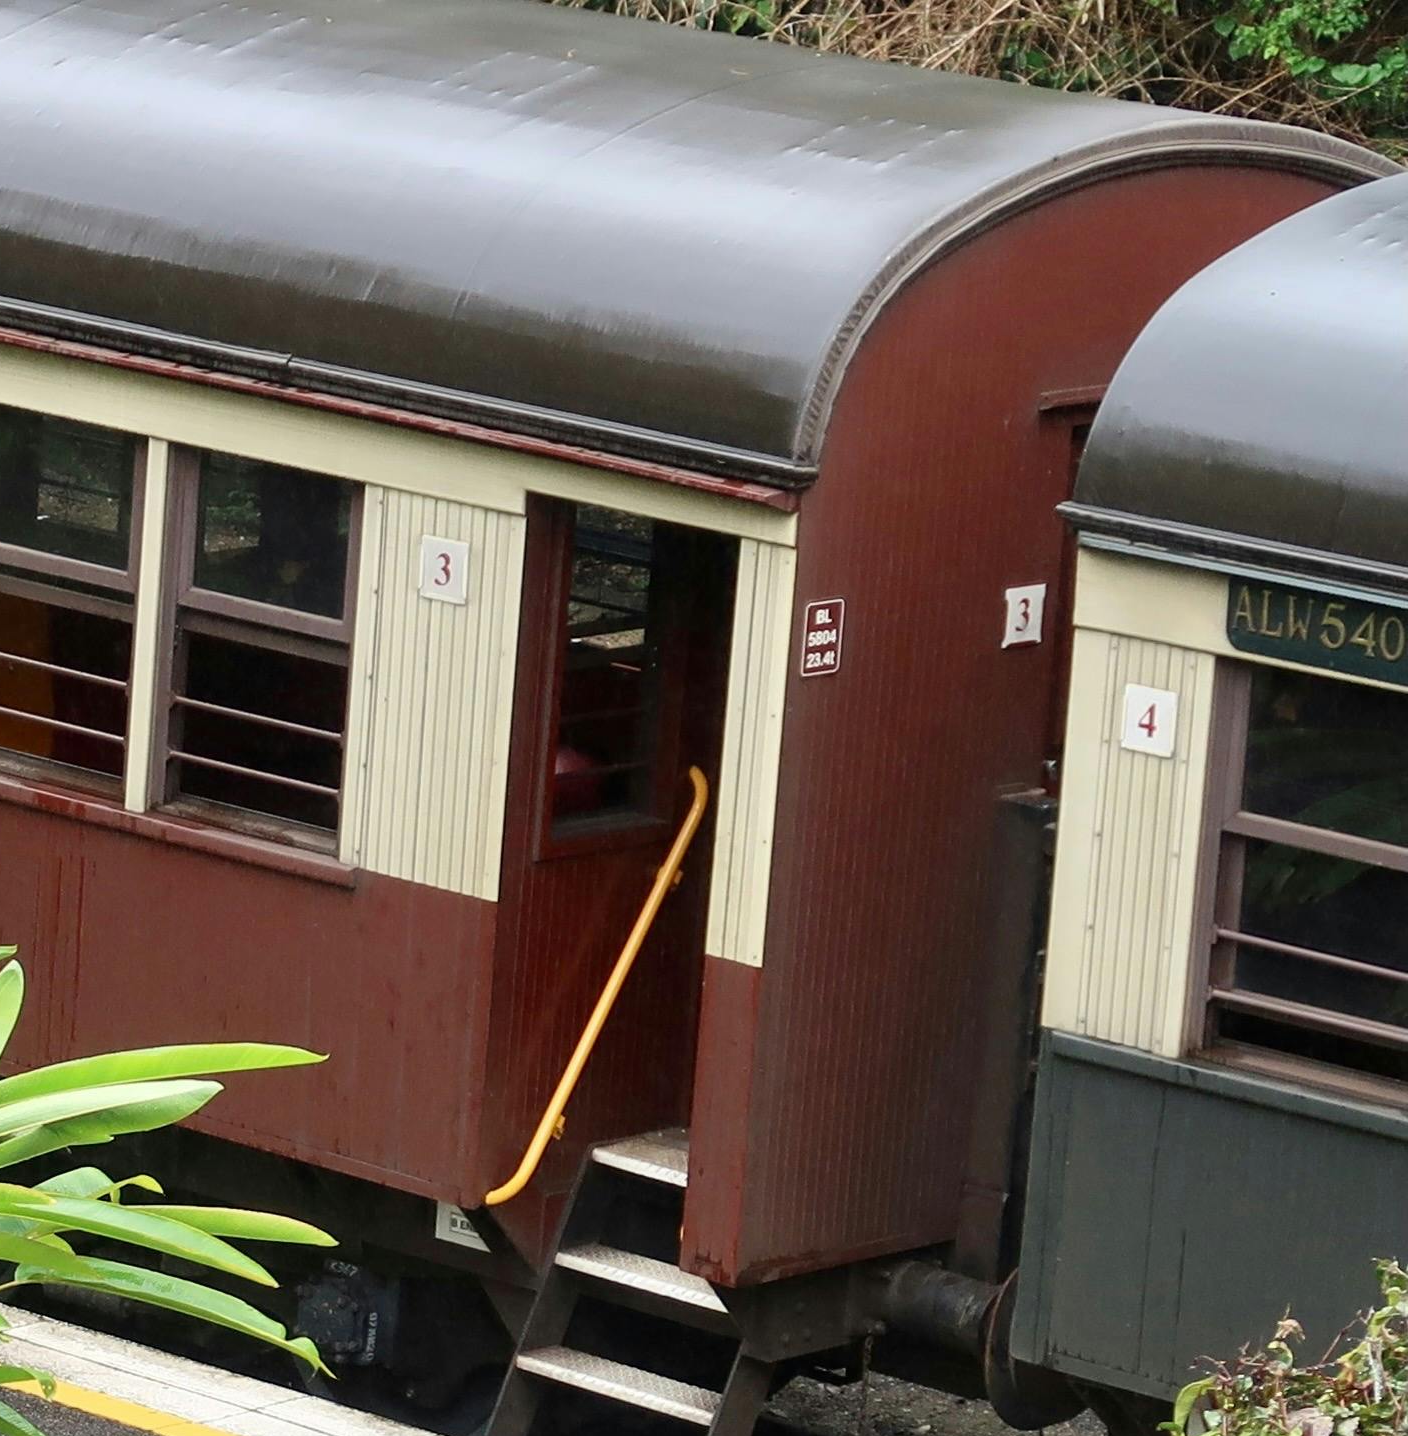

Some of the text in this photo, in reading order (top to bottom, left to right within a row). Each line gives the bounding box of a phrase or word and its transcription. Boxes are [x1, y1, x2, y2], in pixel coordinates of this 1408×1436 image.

[434, 553, 451, 586] 3
[815, 608, 832, 625] BL
[1014, 597, 1031, 633] 3
[808, 628, 837, 647] 5804
[1138, 703, 1158, 739] 4
